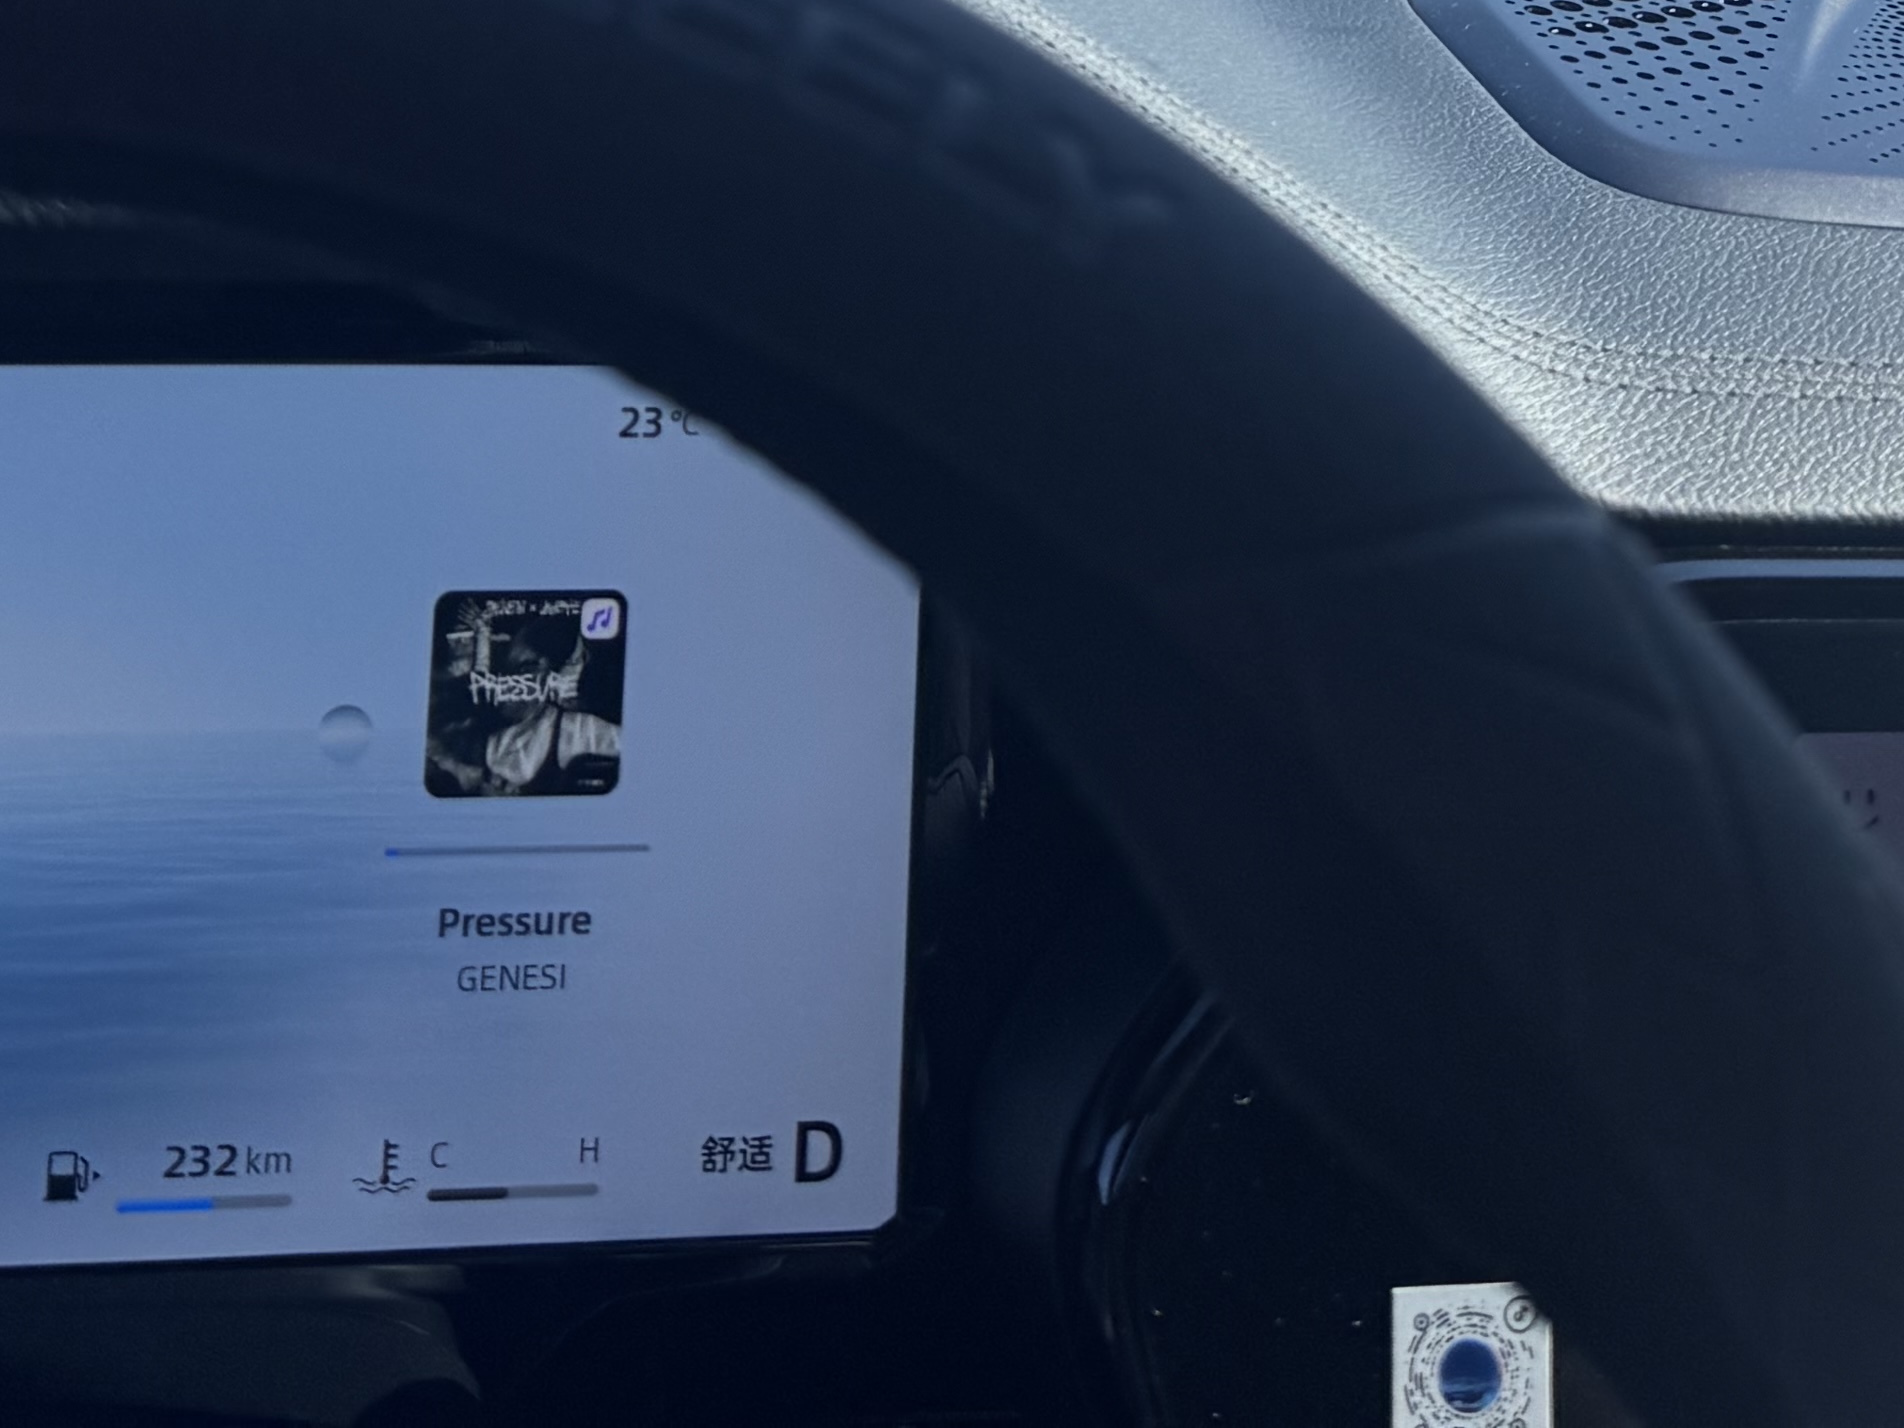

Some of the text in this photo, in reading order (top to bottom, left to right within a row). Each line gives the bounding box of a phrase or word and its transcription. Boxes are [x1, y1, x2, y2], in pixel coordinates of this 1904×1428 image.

[436, 906, 594, 940] Pressure
[455, 962, 568, 994] GENESI
[579, 1137, 600, 1164] H
[700, 1119, 845, 1184] 舒适 D
